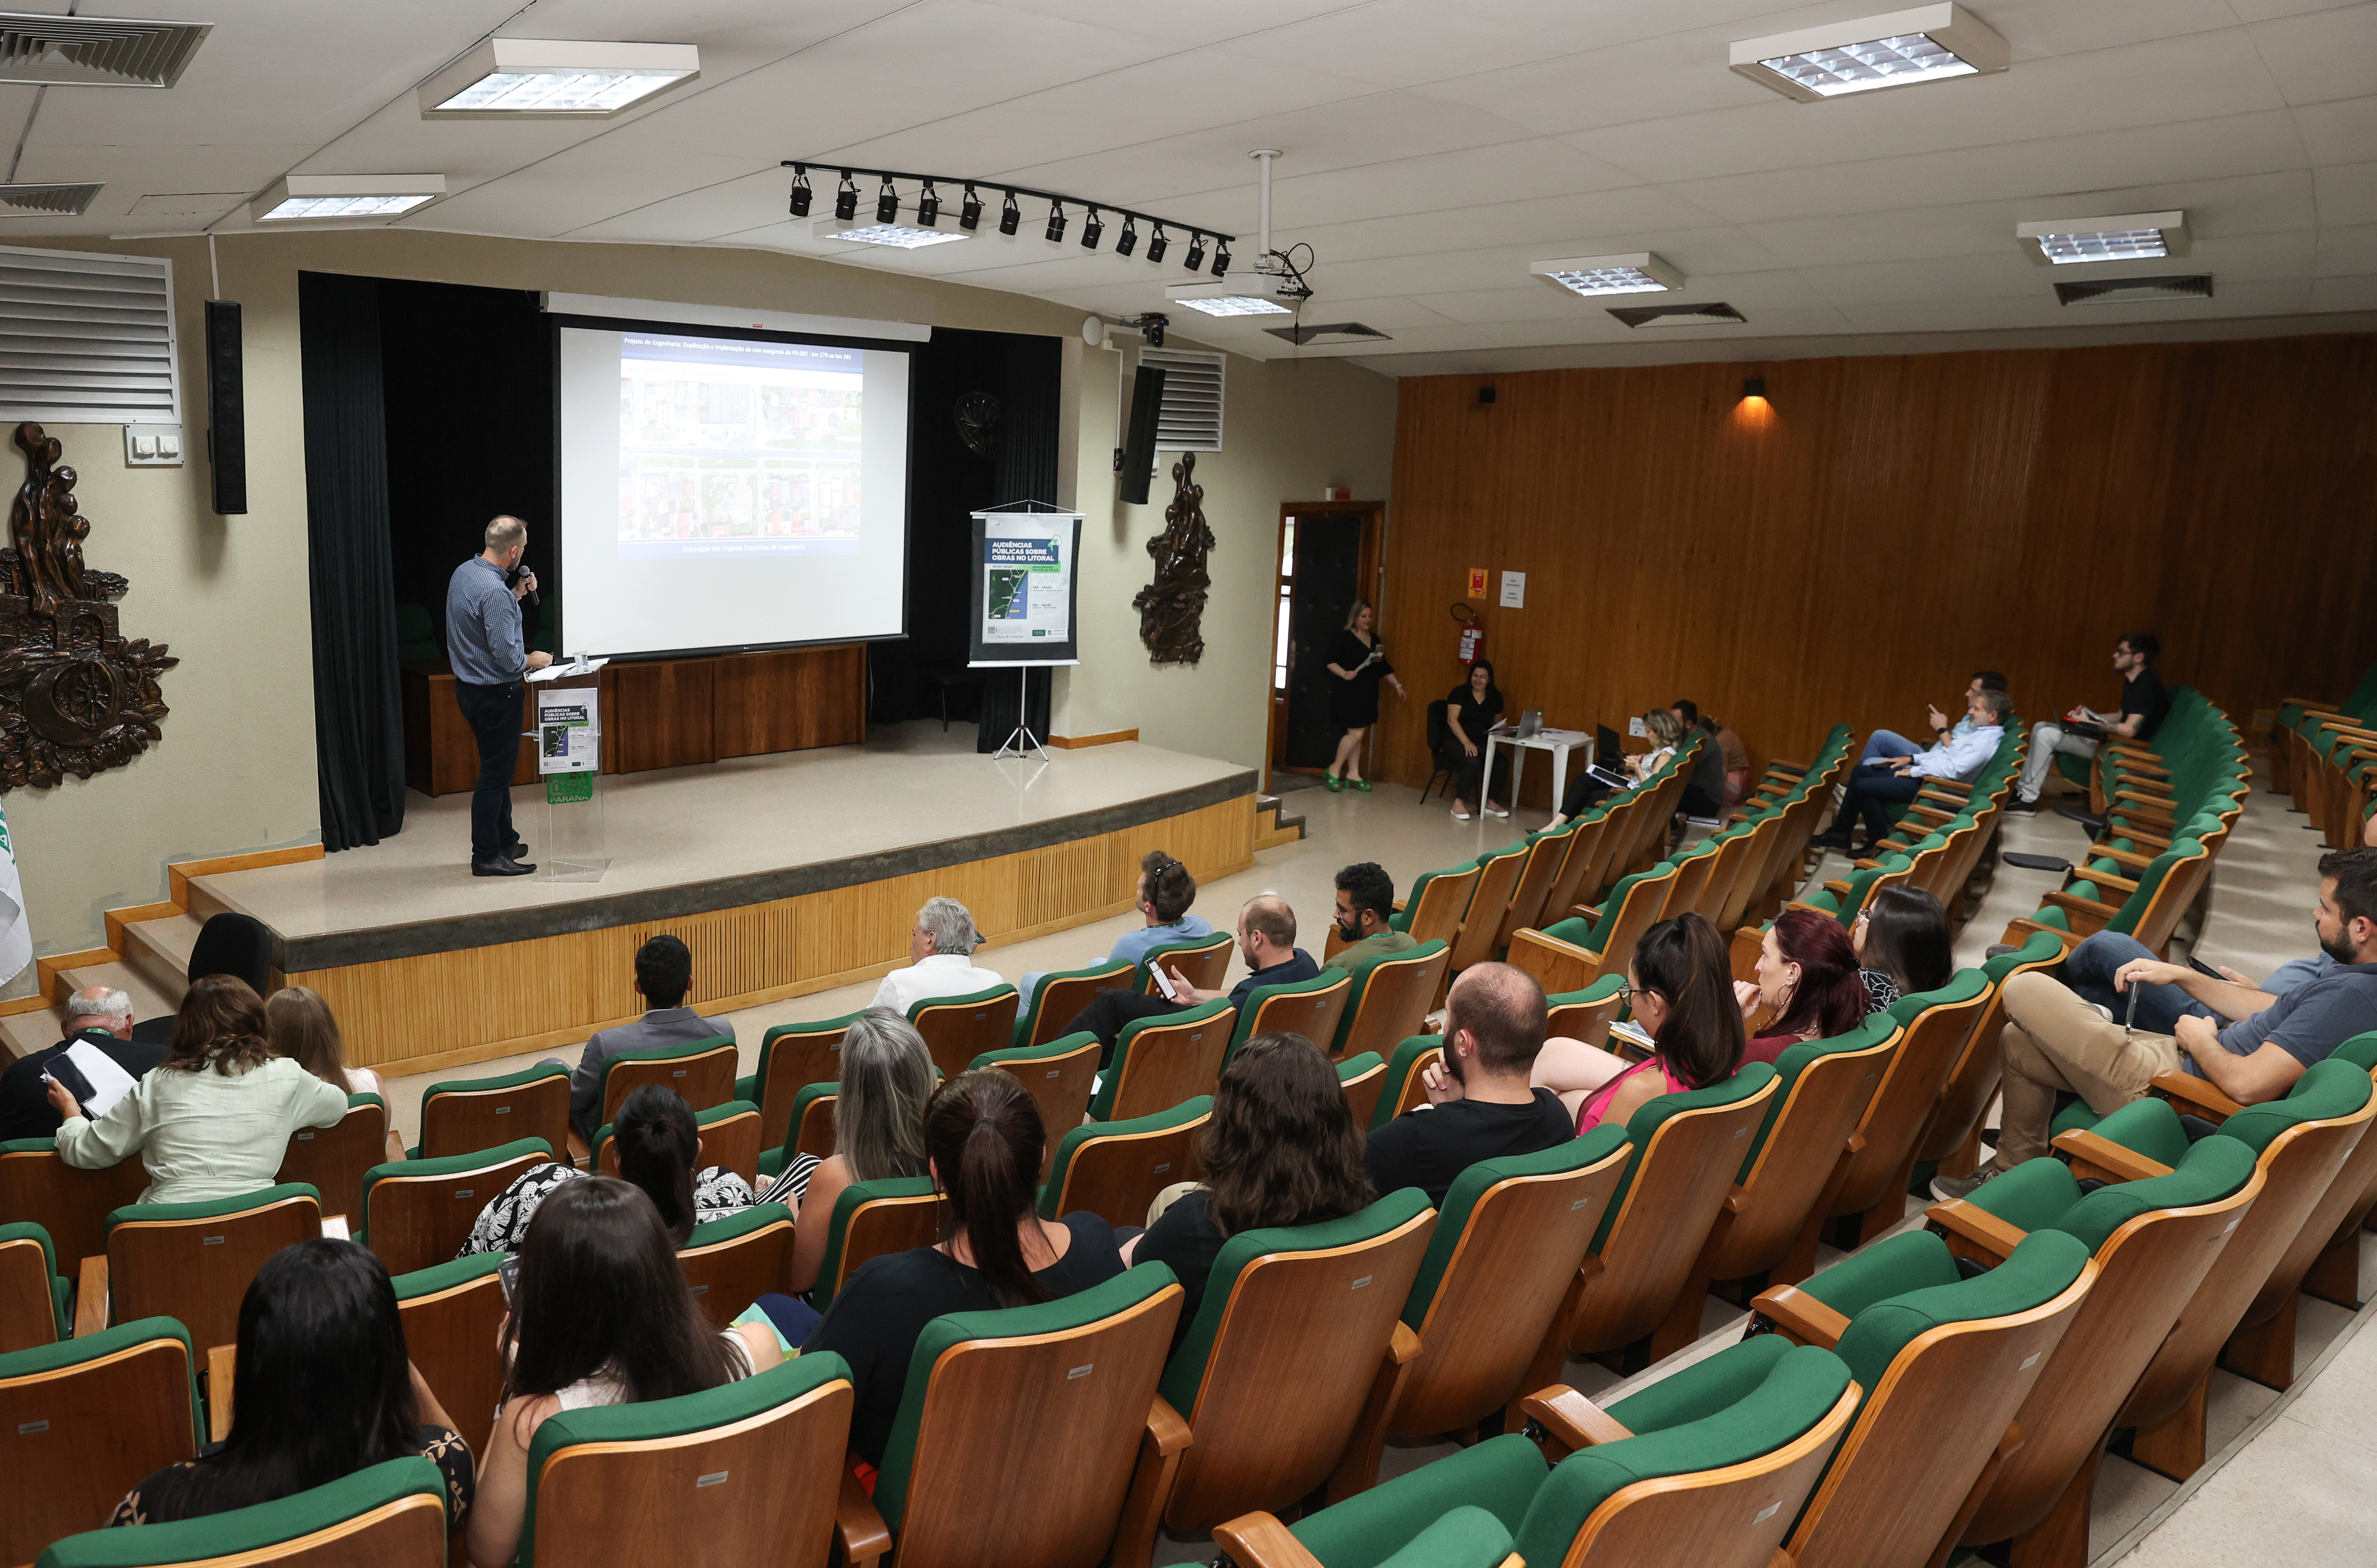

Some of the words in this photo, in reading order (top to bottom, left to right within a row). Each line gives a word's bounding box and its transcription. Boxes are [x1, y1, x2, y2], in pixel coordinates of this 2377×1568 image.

[652, 339, 682, 348] Engenharia:
[683, 342, 710, 350] Duplicação
[715, 344, 744, 353] implantação
